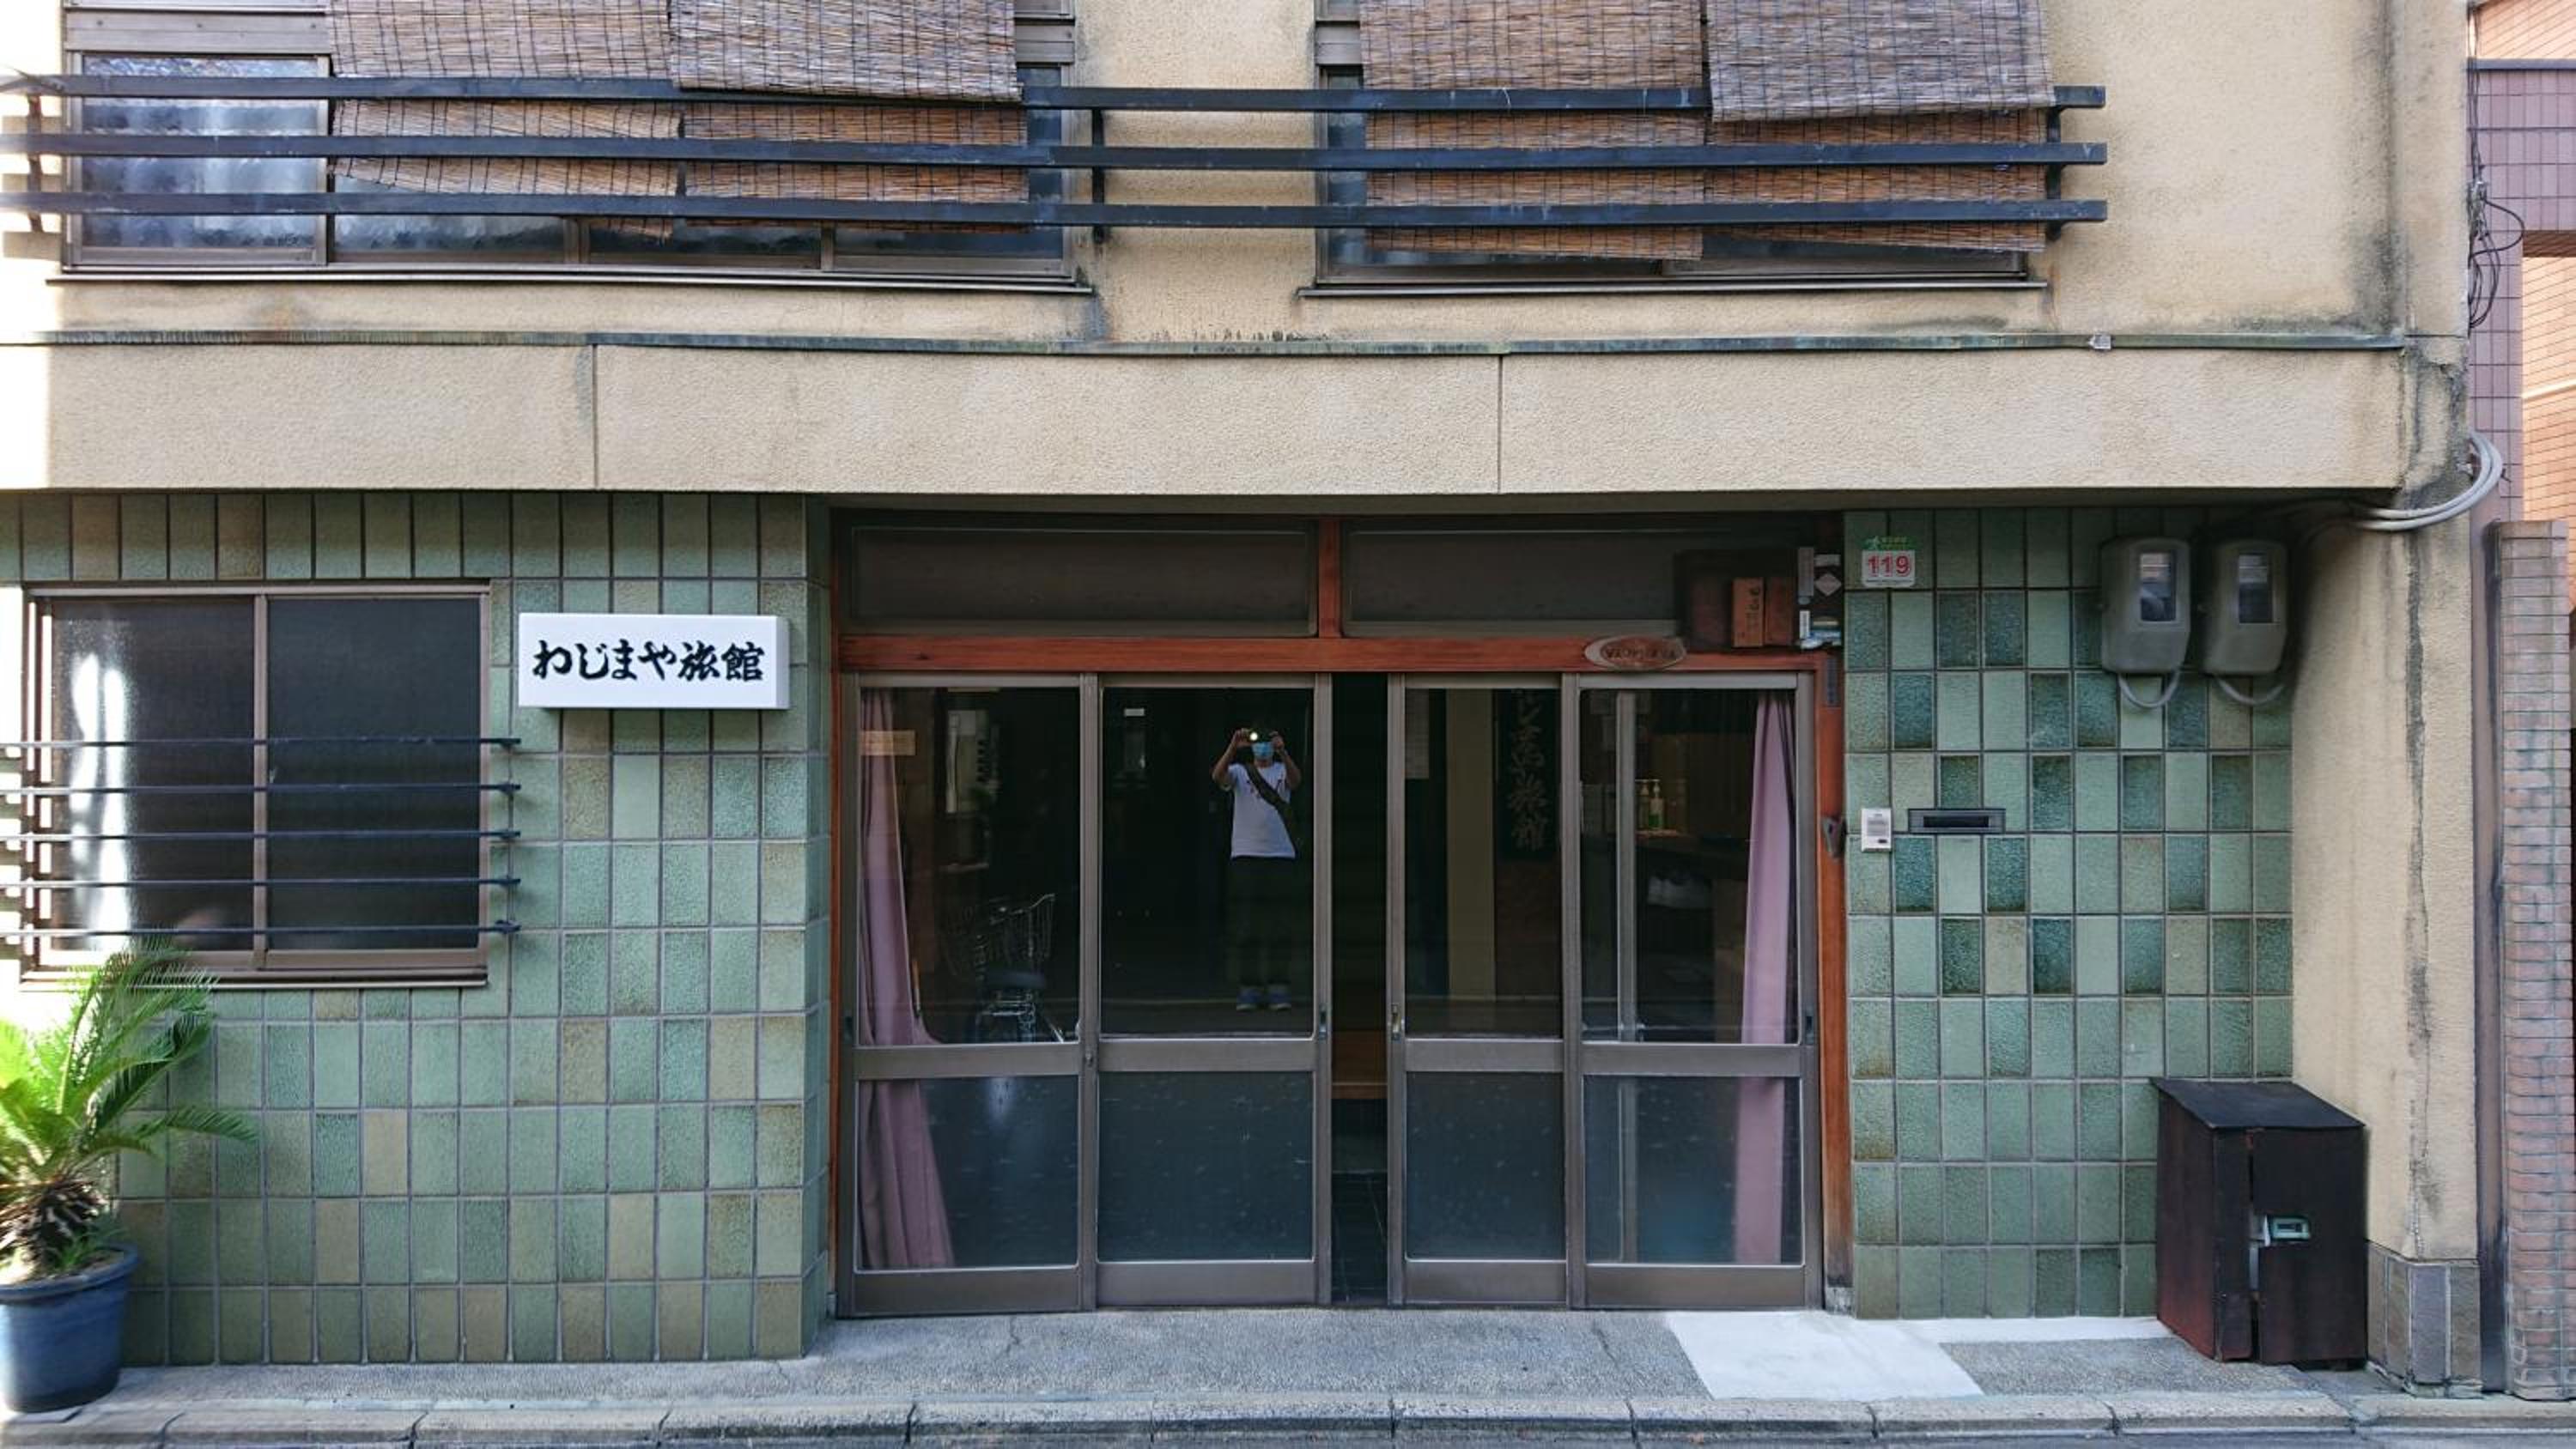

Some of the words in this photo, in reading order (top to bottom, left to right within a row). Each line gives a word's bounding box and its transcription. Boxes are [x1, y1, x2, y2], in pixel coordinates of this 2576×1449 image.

[1868, 555, 1911, 576] 119
[532, 639, 765, 682] わじまや旅館
